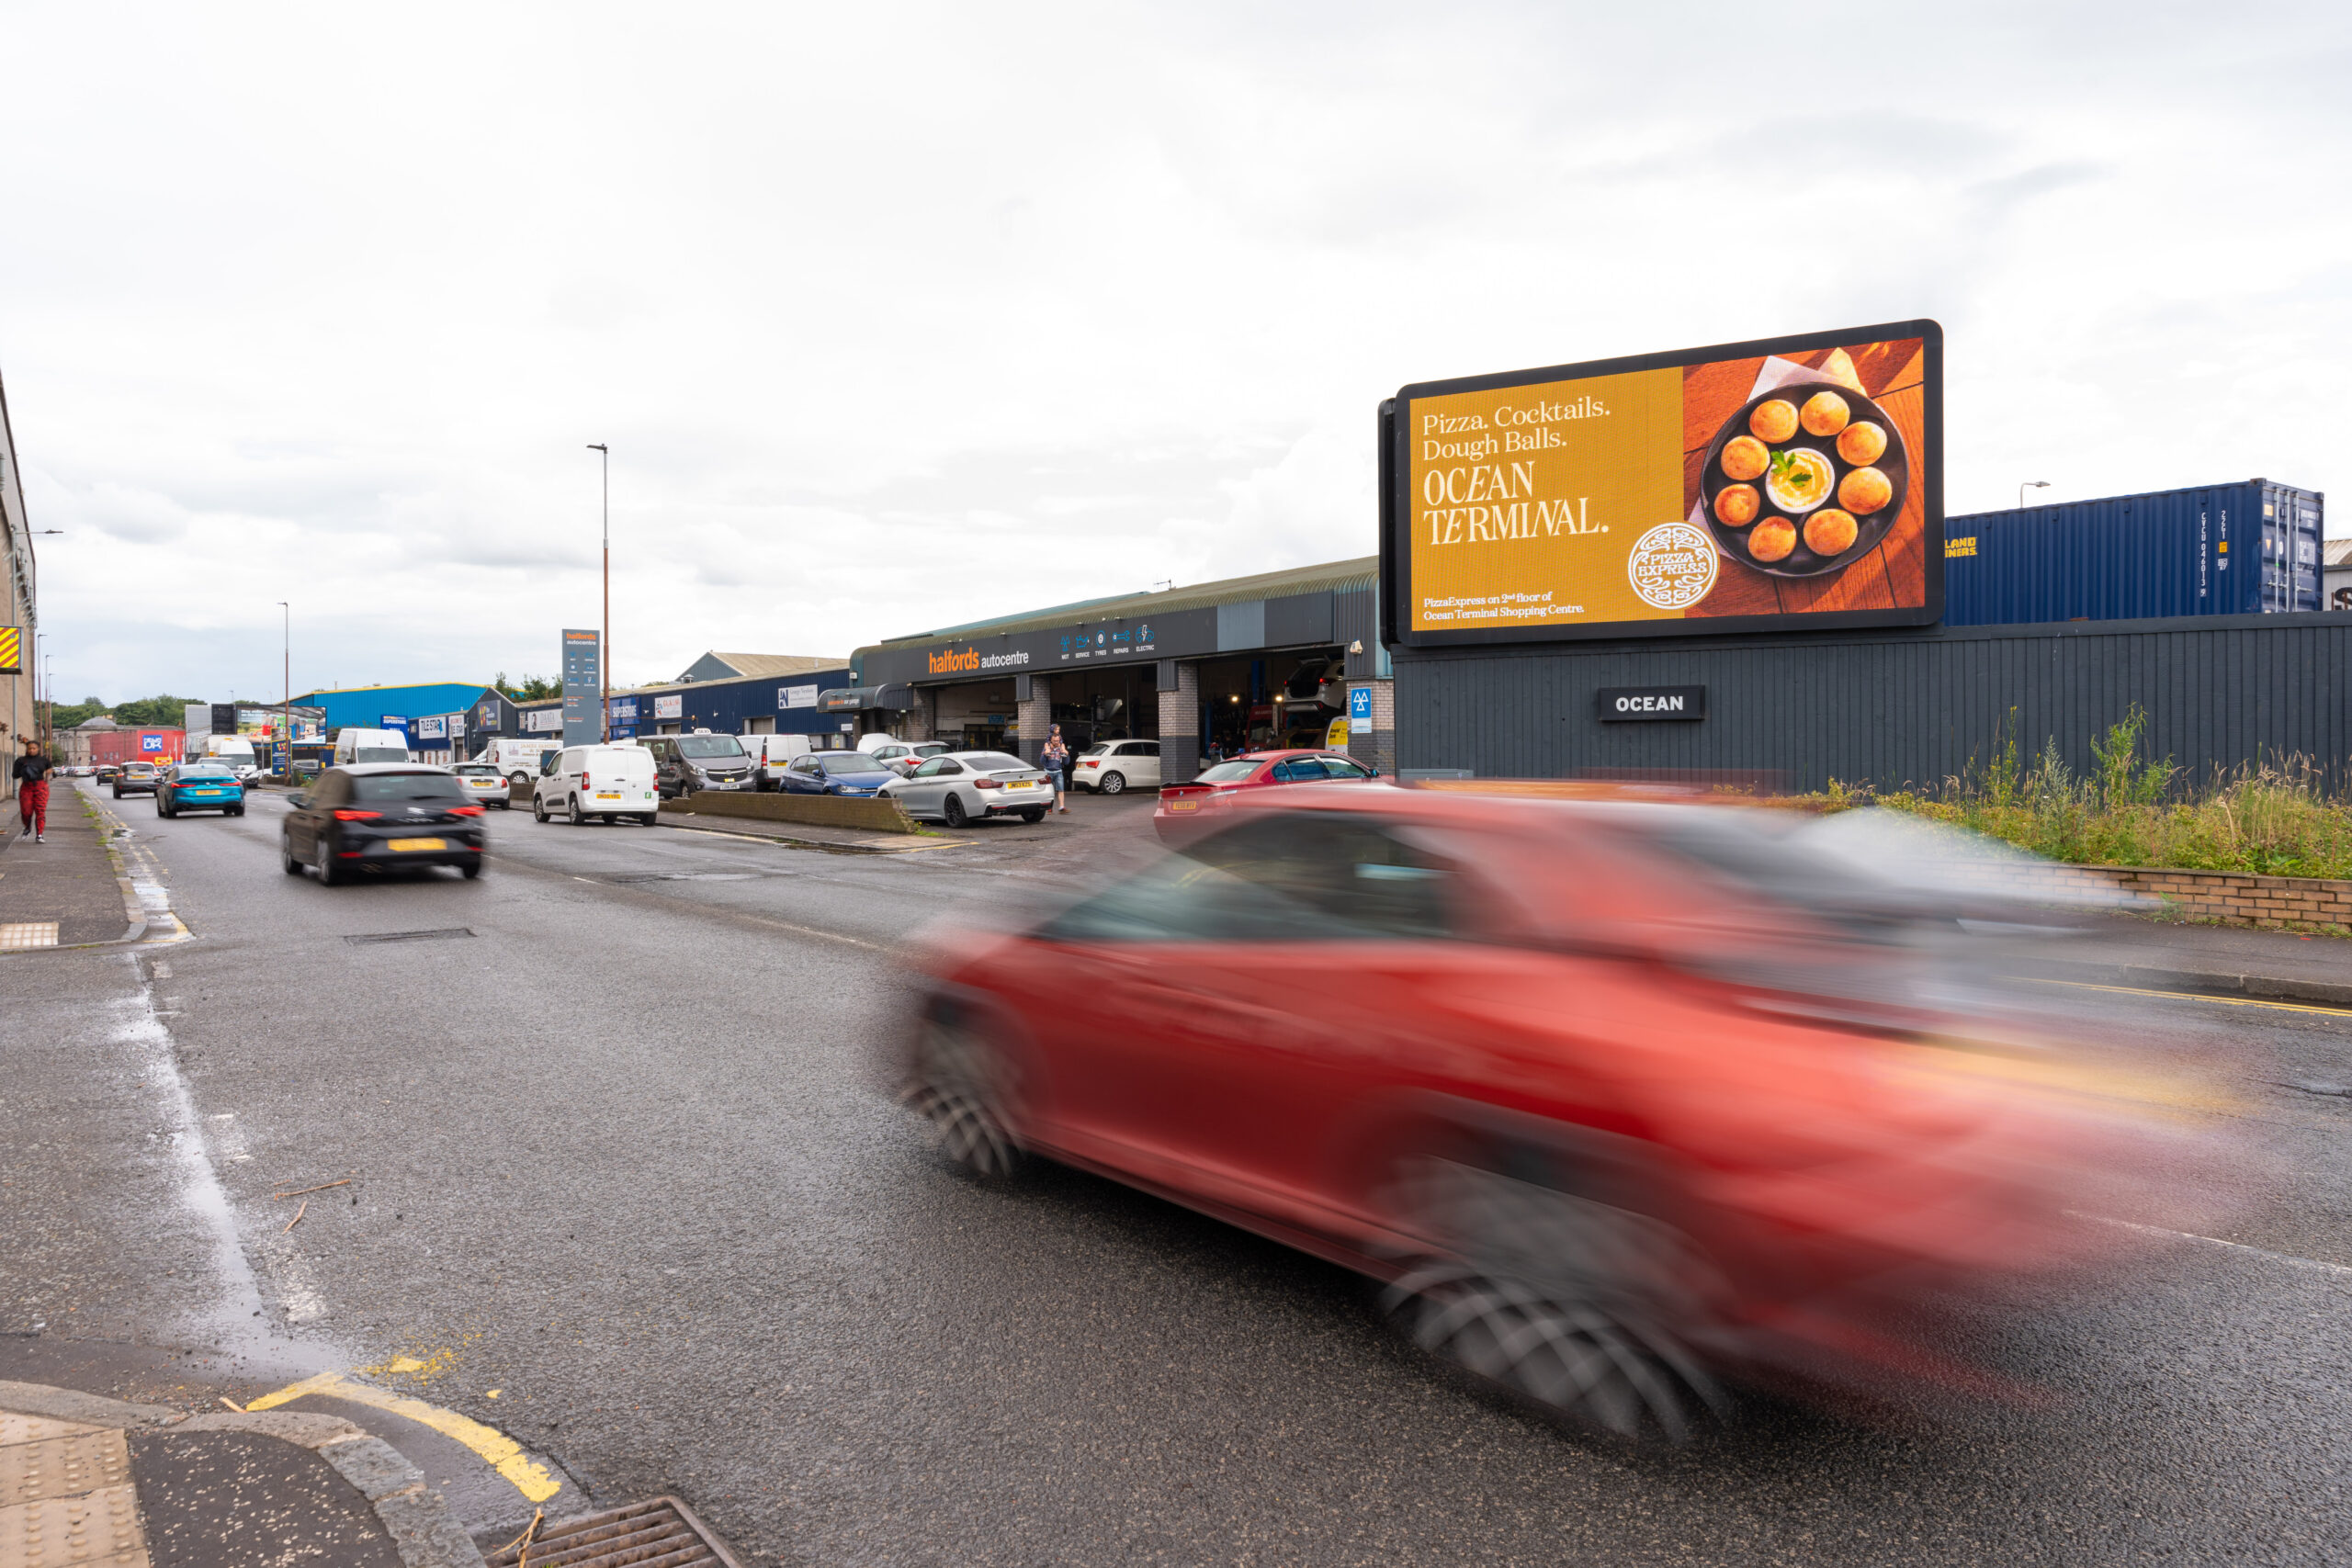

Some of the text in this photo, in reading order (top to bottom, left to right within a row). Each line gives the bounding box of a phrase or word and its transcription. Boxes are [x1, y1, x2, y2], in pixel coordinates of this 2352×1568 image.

[1423, 396, 1611, 435] Pizza. Cocktails.
[1423, 428, 1567, 461] Dough Balls.
[1424, 461, 1535, 505] OCEAN
[1424, 498, 1609, 545] TERMINAL.
[1650, 552, 1694, 565] PIZZA
[1638, 562, 1707, 576] EXPRESS
[1424, 597, 1486, 608] PizzaExpress
[1516, 593, 1540, 603] floor
[1542, 592, 1553, 601] of
[1424, 604, 1584, 620] Ocean Terminal Shopping Centre.
[929, 647, 1029, 674] halfords autocentre
[613, 705, 637, 717] SUPERSTORE
[1616, 696, 1683, 712] OCEAN
